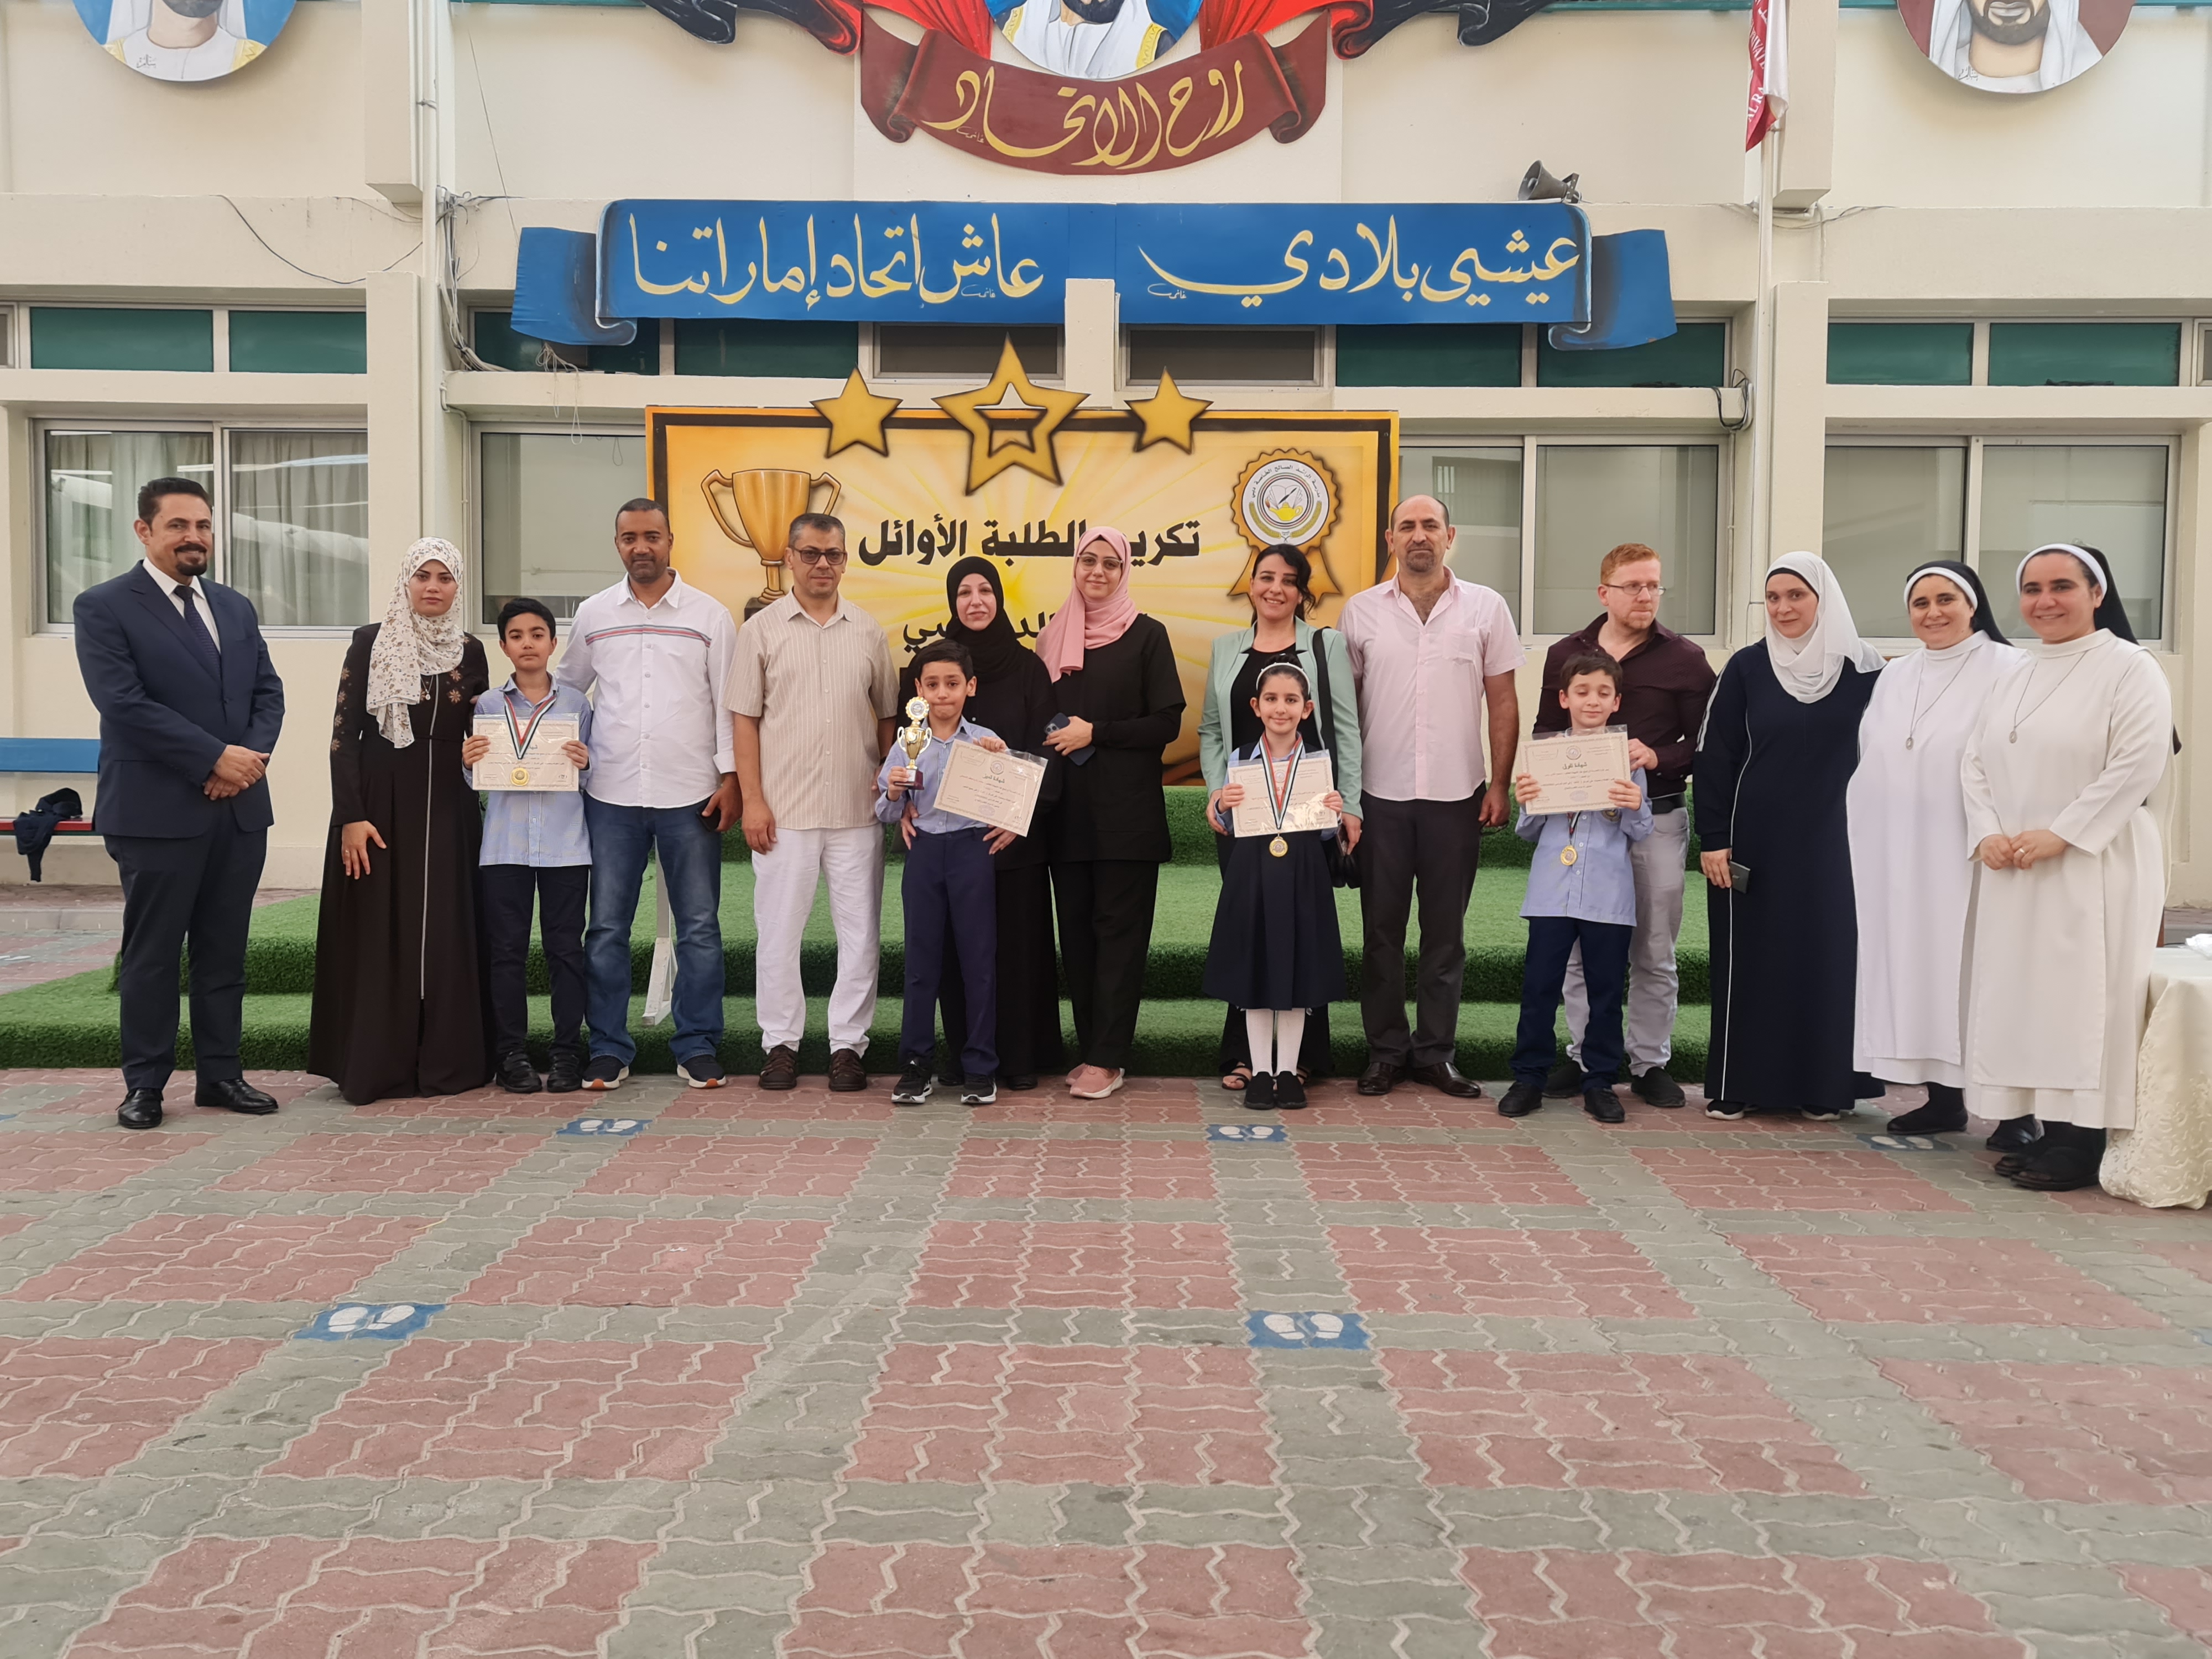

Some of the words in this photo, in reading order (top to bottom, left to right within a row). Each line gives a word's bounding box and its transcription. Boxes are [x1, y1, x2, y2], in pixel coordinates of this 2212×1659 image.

[628, 212, 821, 311] إماراتنا
[826, 213, 921, 299] اتحاد
[919, 212, 1044, 304] عاش
[1138, 215, 1420, 308] بلادي
[1420, 229, 1580, 307] عيشي
[858, 513, 968, 566] الأوائل
[1129, 519, 1201, 567] تكري
